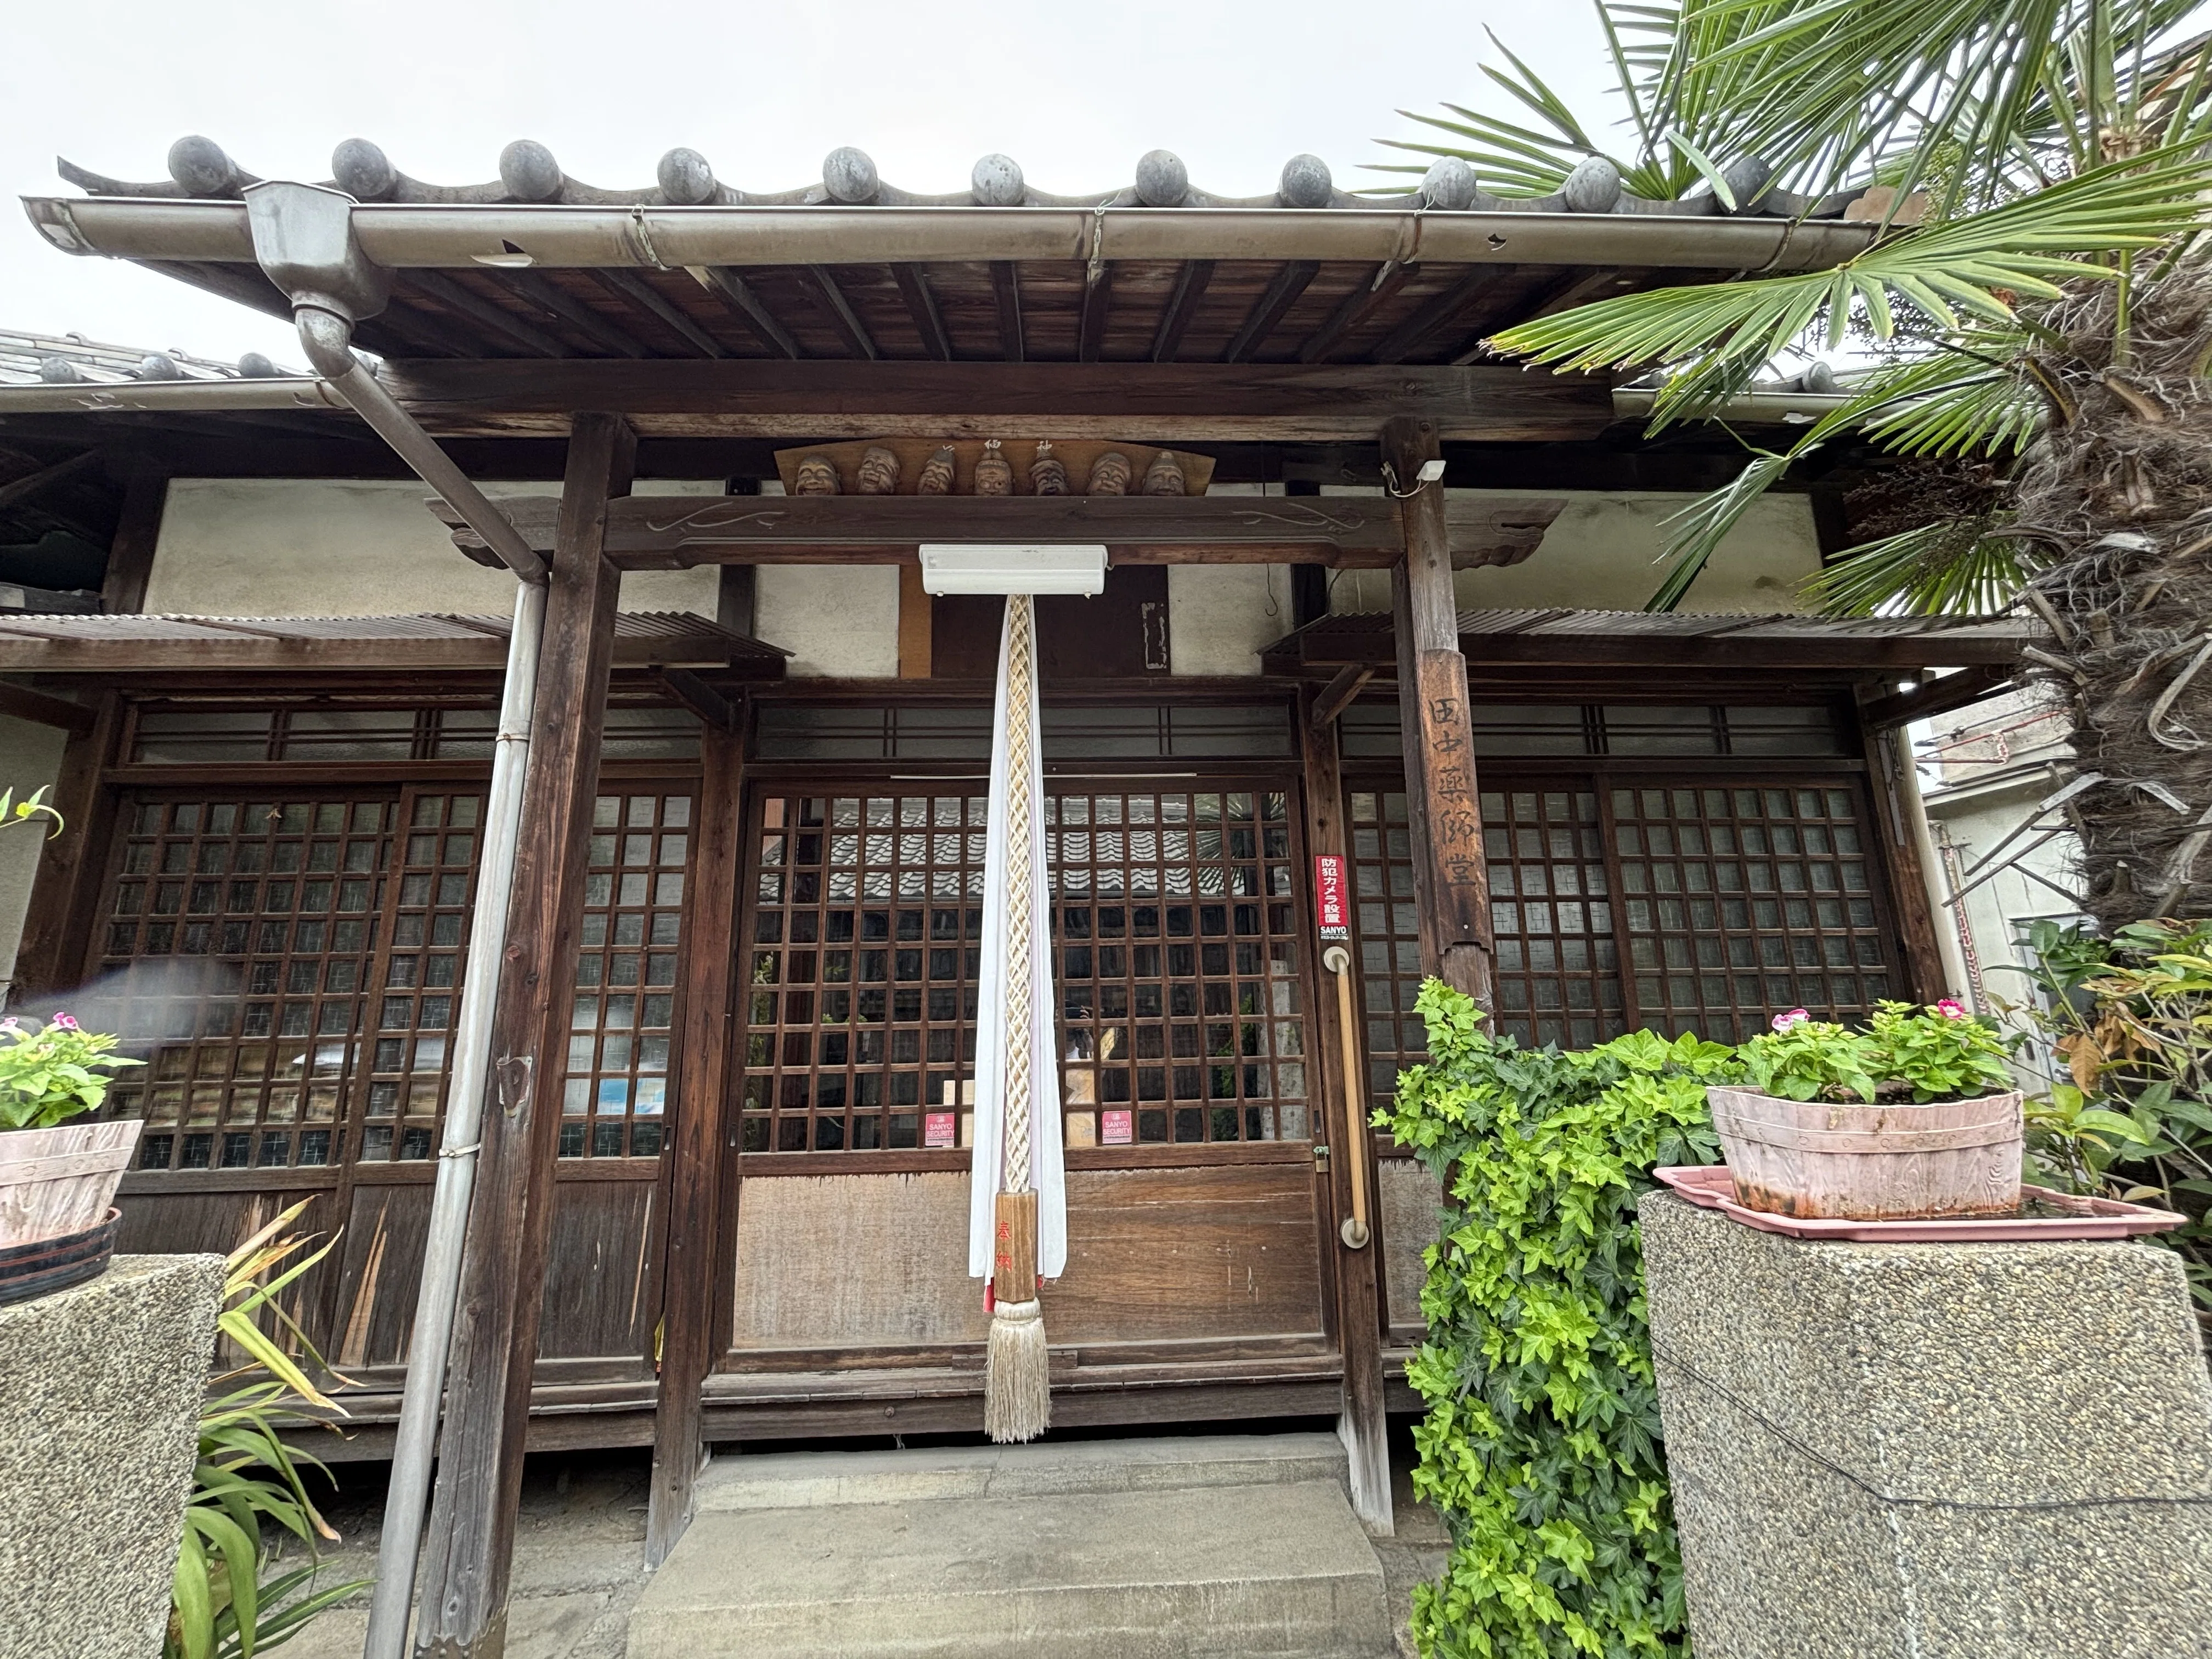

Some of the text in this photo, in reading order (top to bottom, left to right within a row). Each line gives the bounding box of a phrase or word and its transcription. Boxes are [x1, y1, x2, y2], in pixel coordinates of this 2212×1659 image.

[1321, 858, 1341, 923] 防犯カメラ設置
[996, 1221, 1012, 1272] 奉納
